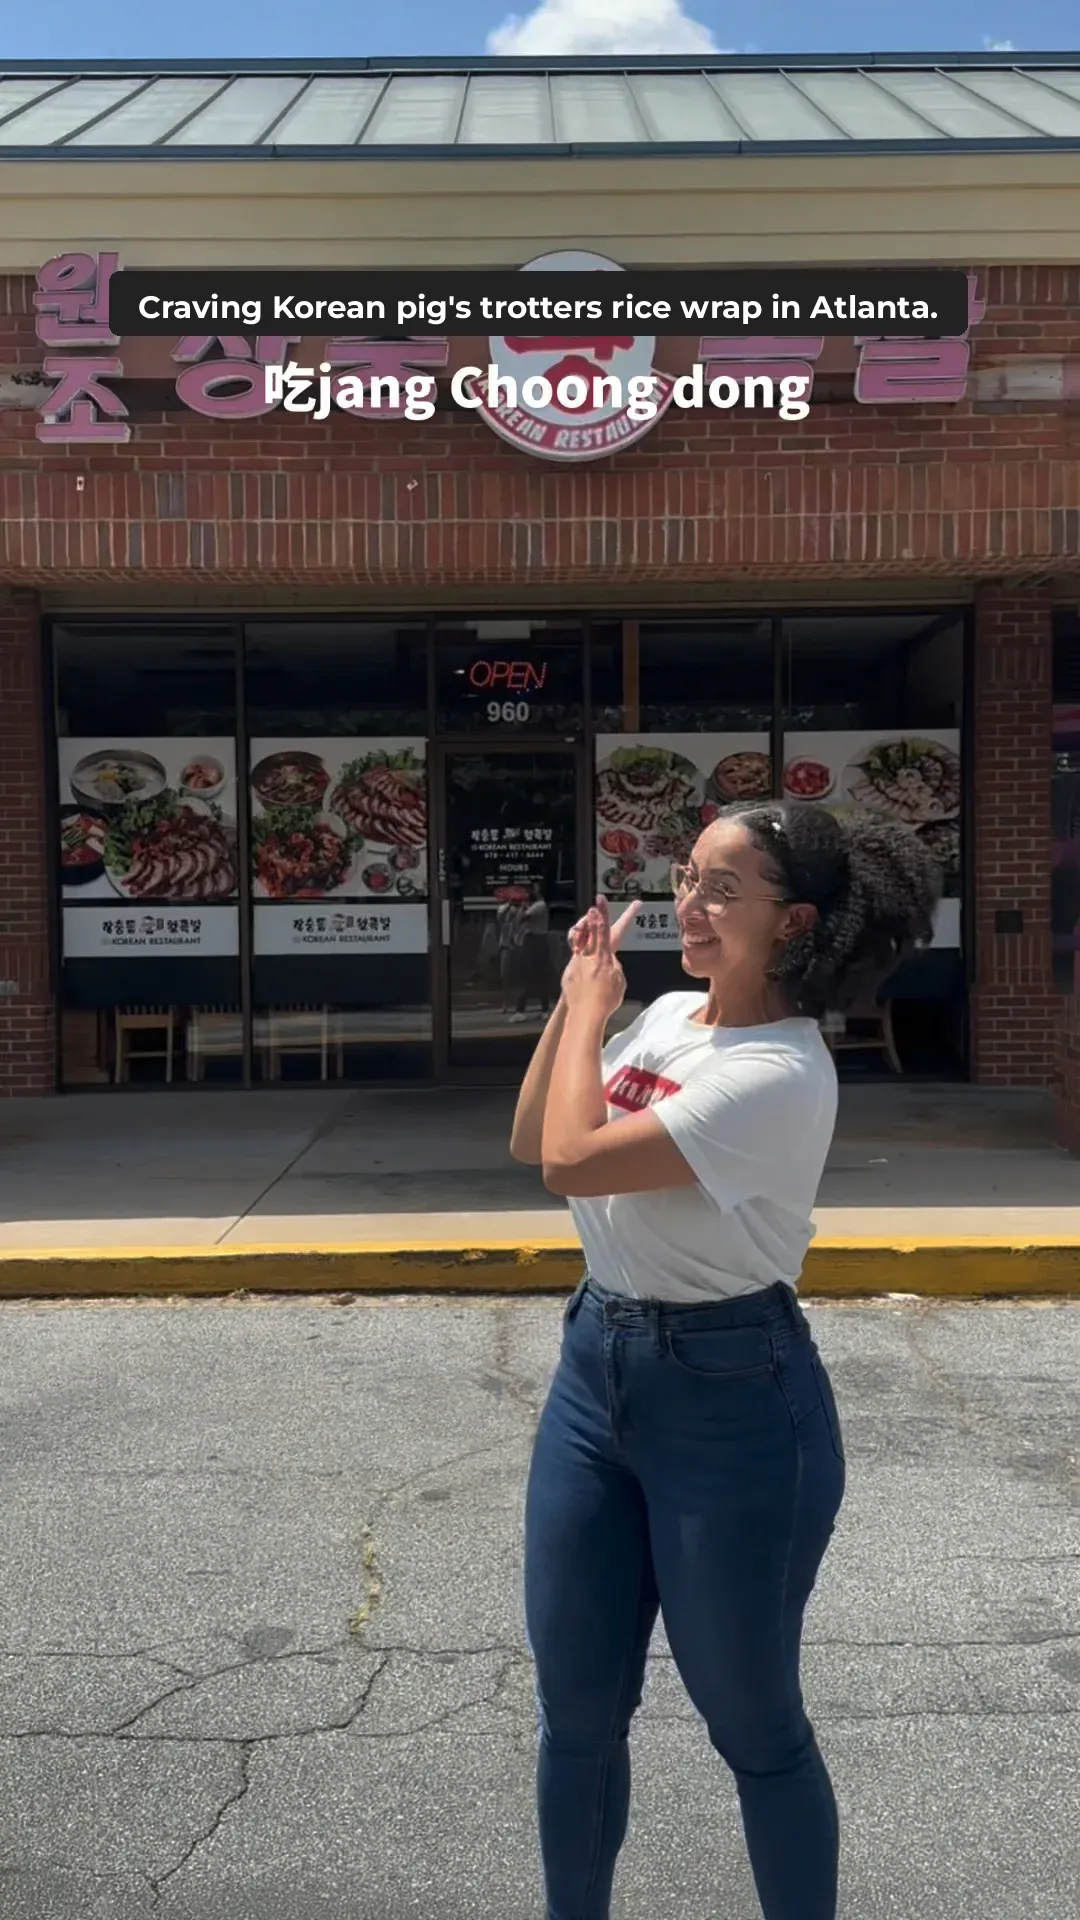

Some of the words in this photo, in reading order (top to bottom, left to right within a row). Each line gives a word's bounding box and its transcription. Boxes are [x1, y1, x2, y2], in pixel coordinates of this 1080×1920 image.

[469, 660, 547, 688] OPEN
[487, 701, 529, 723] 960
[112, 937, 146, 945] KOREAN
[149, 936, 201, 945] RESTAURANT
[302, 935, 336, 943] KOREAN
[339, 934, 391, 943] RESTAURANT
